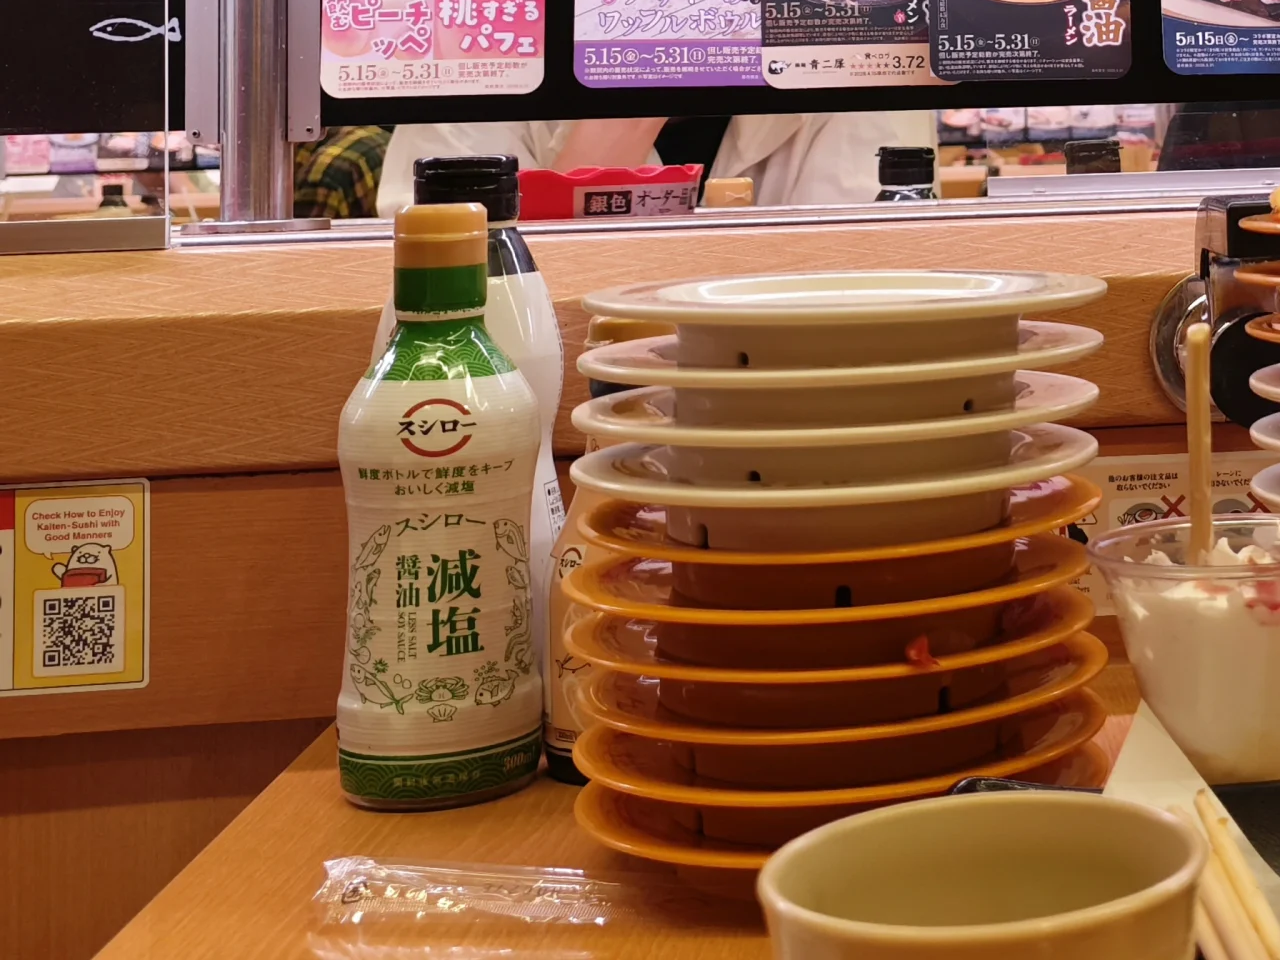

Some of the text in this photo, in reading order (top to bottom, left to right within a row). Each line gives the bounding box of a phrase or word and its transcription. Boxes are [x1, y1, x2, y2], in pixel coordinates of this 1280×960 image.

[598, 6, 762, 36] ワッフルボウル
[1064, 4, 1078, 45] ラーメン
[460, 23, 537, 55] パフェ
[892, 56, 925, 69] 3.72
[396, 419, 477, 436] スシロー
[358, 458, 515, 481] 鮮度ボトルで鮮度をキープ
[394, 480, 475, 496] おいしく減塩
[31, 508, 125, 521] Check How to Enjoy
[37, 519, 120, 531] Kaiten-Sushi with
[395, 513, 486, 537] スシロー
[44, 531, 112, 541] Good Manners
[395, 555, 421, 608] 醤油
[427, 548, 485, 657] 減塩
[397, 612, 406, 663] SOY SAUCE
[408, 612, 417, 660] LESS SALT
